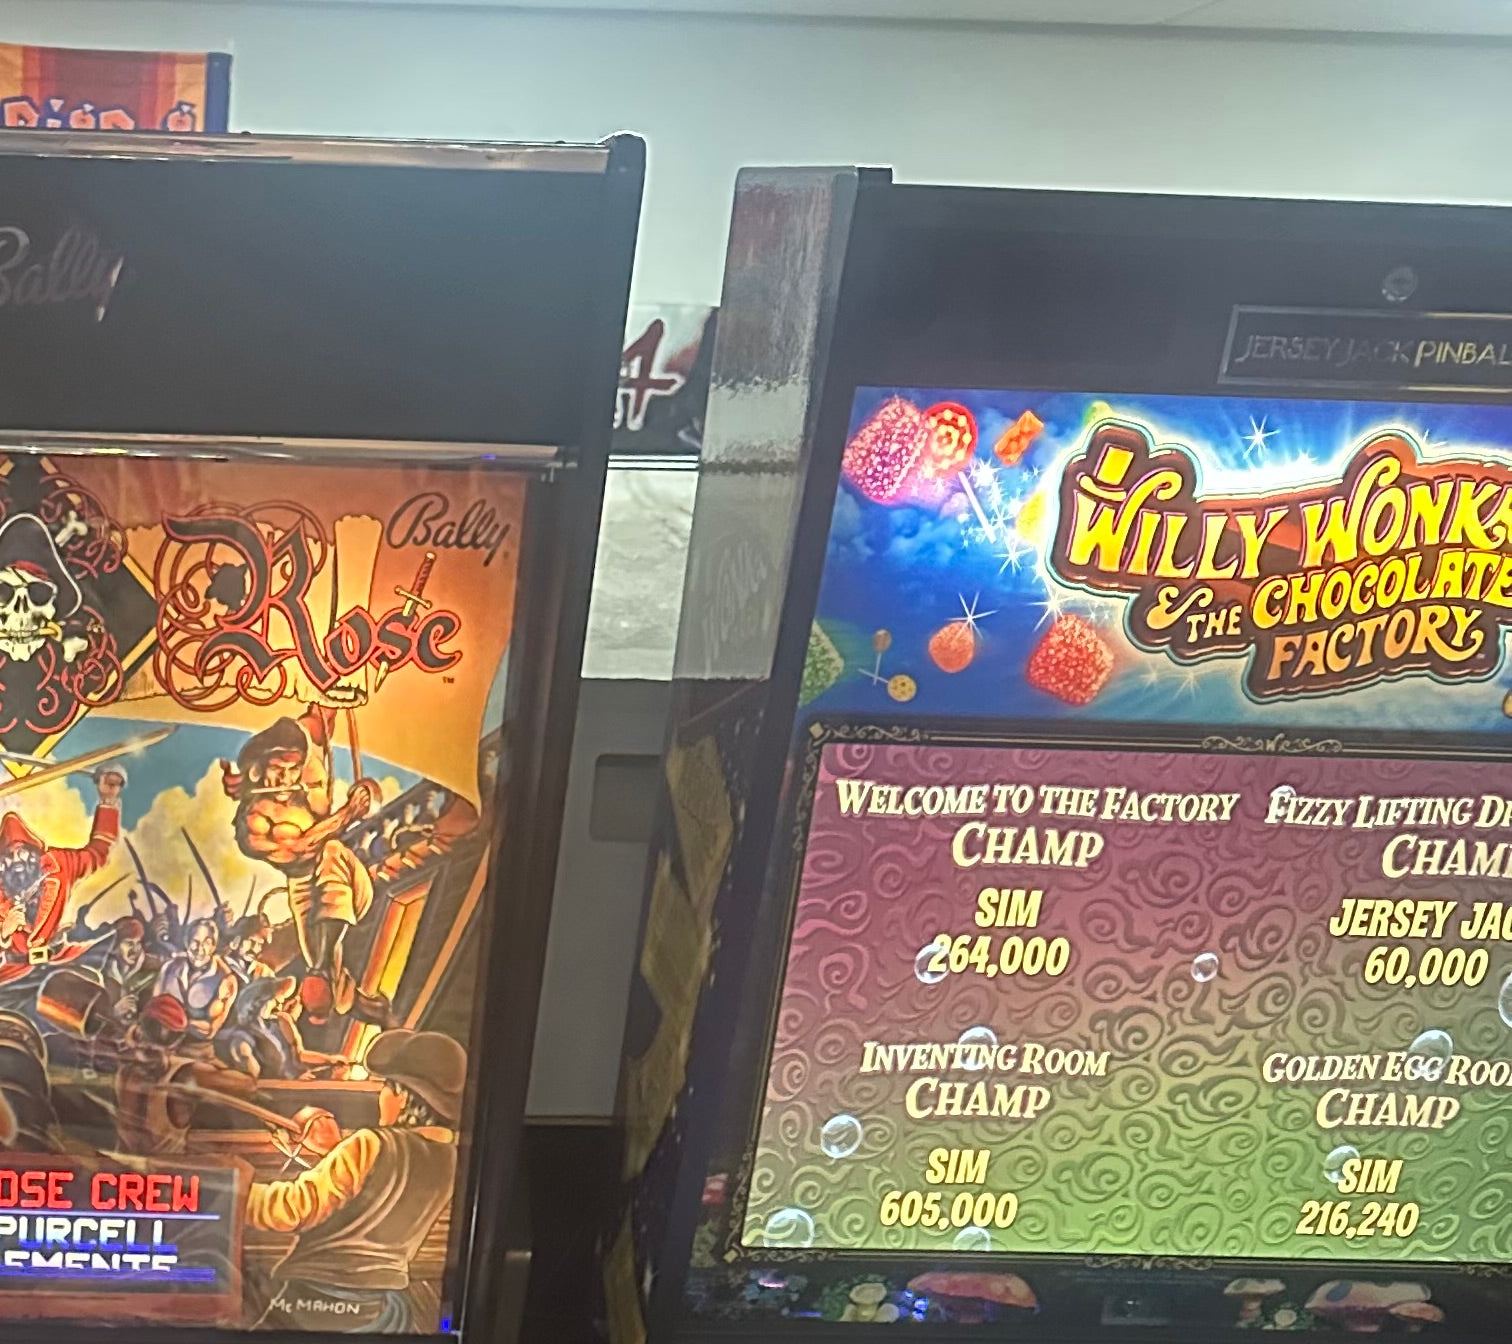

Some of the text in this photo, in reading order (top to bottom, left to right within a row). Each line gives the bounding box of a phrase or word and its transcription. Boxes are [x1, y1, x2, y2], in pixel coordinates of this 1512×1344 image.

[1235, 334, 1340, 362] JERSEY
[1336, 337, 1415, 367] JACK
[386, 491, 511, 567] Bally
[1068, 456, 1512, 580] WILLY WONK
[156, 505, 463, 708] Rose
[1146, 586, 1214, 630] &
[1186, 604, 1241, 642] THE
[1267, 604, 1485, 681] FACTORY
[835, 779, 1240, 823] WELCOME TO THE FACTORY
[1264, 791, 1355, 829] FIZZY
[1353, 795, 1474, 829] LIFTING
[951, 821, 1104, 868] CHAMP
[974, 887, 1043, 928] SIM
[1329, 899, 1457, 938] JERSEY
[928, 934, 1070, 977] 264,000
[1364, 946, 1489, 988] 60,000
[860, 1041, 1110, 1076] INVENTING ROOM
[1263, 1053, 1381, 1083] GOLDEN
[905, 1077, 1051, 1119] CHAMP
[1316, 1088, 1460, 1129] CHAMP
[925, 1148, 990, 1184] SIM
[1338, 1158, 1403, 1194] SIM
[90, 1173, 200, 1212] CREW
[880, 1190, 1018, 1230] 605,000
[1296, 1200, 1419, 1239] 216,240
[296, 1298, 360, 1315] MAHON
